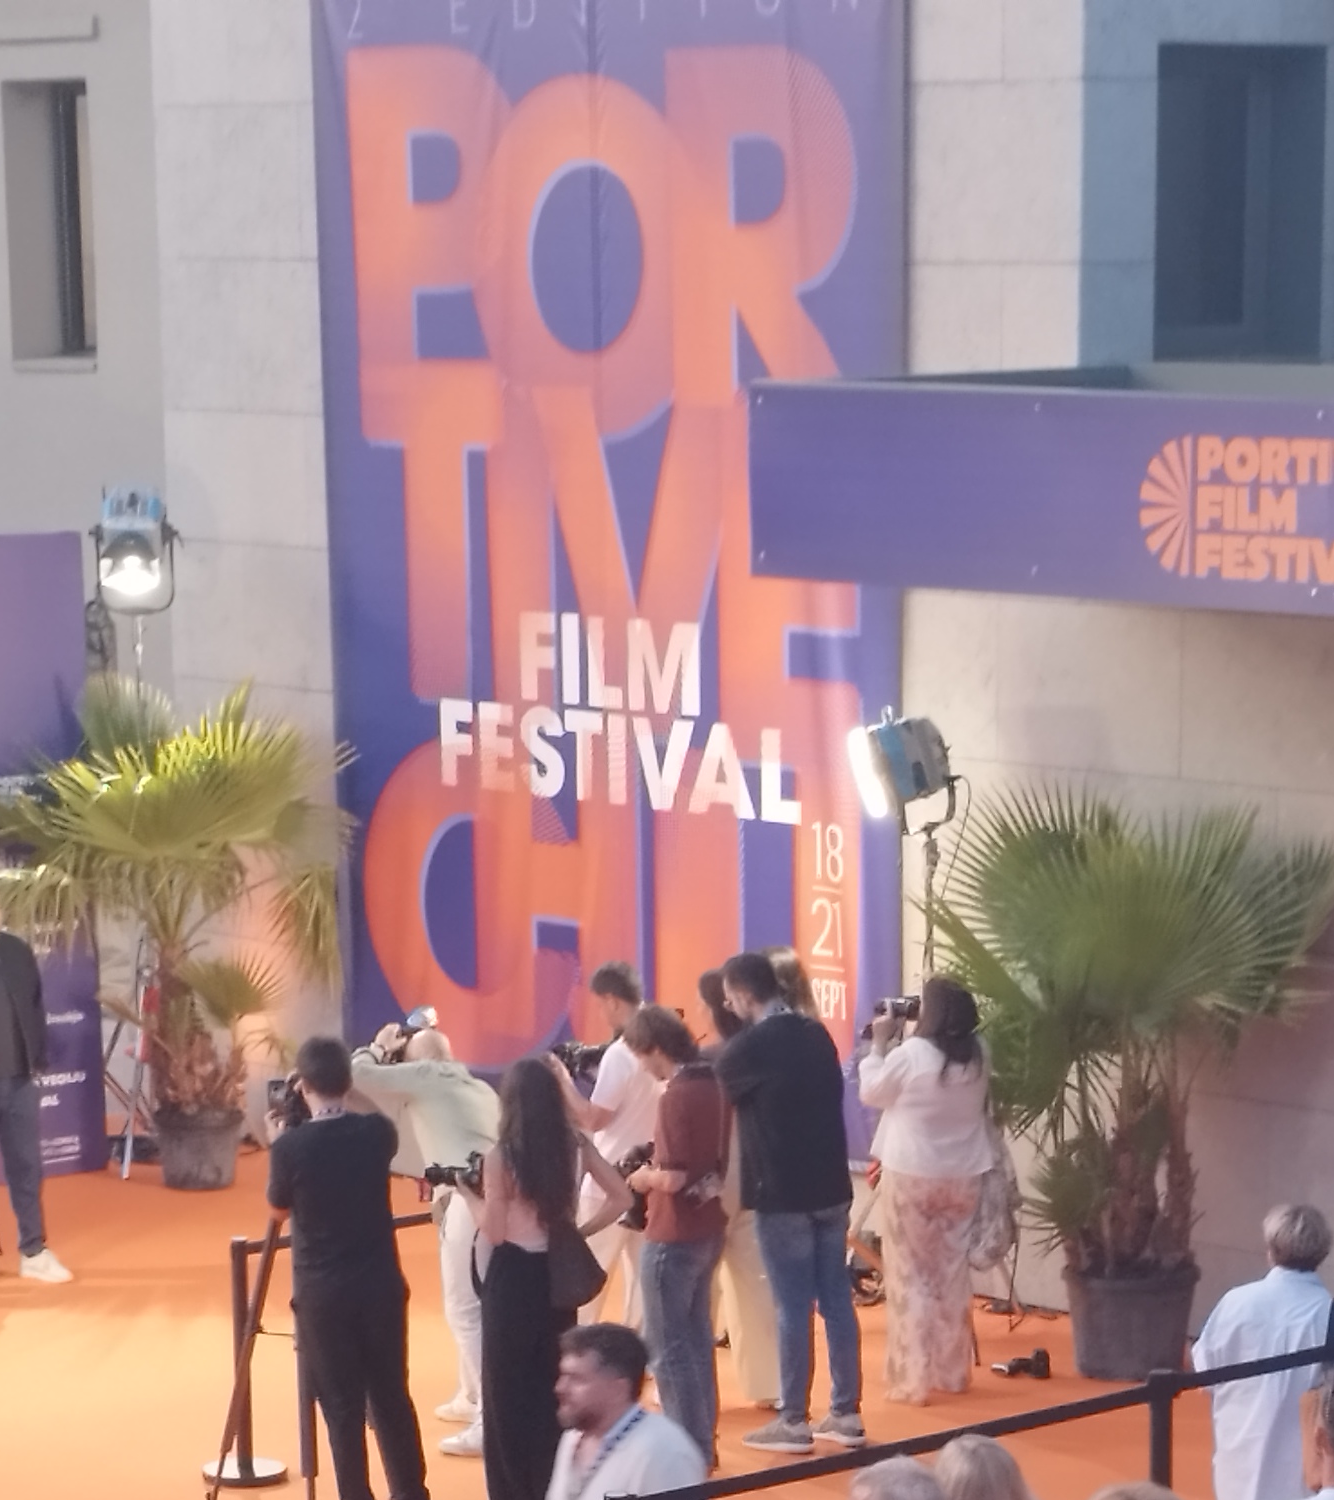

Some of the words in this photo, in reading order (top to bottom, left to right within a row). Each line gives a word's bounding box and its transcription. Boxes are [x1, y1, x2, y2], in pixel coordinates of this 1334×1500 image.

[347, 45, 859, 441] POR
[1196, 485, 1298, 533] FILM
[519, 611, 701, 716] FILM
[439, 698, 801, 825] FESTIVAL
[811, 820, 844, 883] 18
[811, 898, 843, 960] 21
[812, 977, 848, 1021] SEPT
